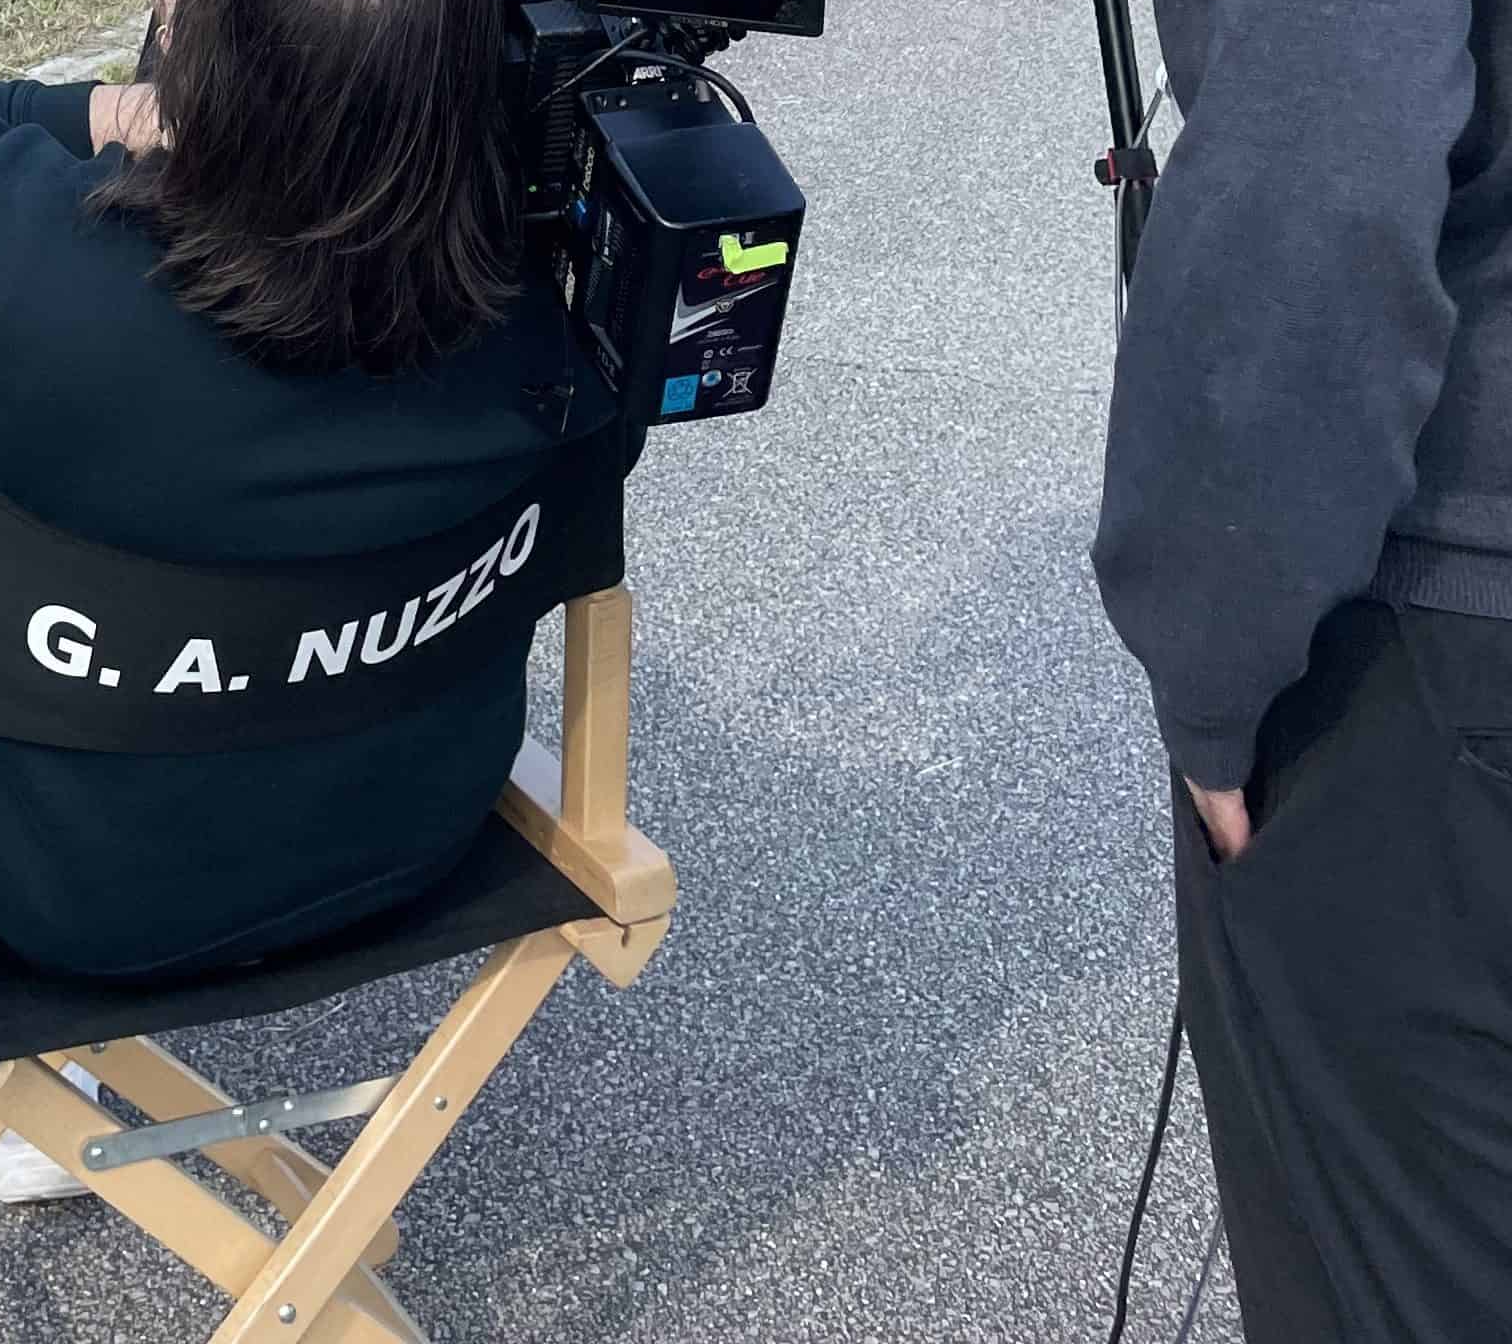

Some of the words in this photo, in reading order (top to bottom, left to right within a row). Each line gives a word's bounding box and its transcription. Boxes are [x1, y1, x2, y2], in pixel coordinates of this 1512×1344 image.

[633, 65, 663, 80] ARRI
[25, 604, 121, 688] G.
[152, 638, 251, 694] A.
[287, 503, 541, 685] NUZZO
